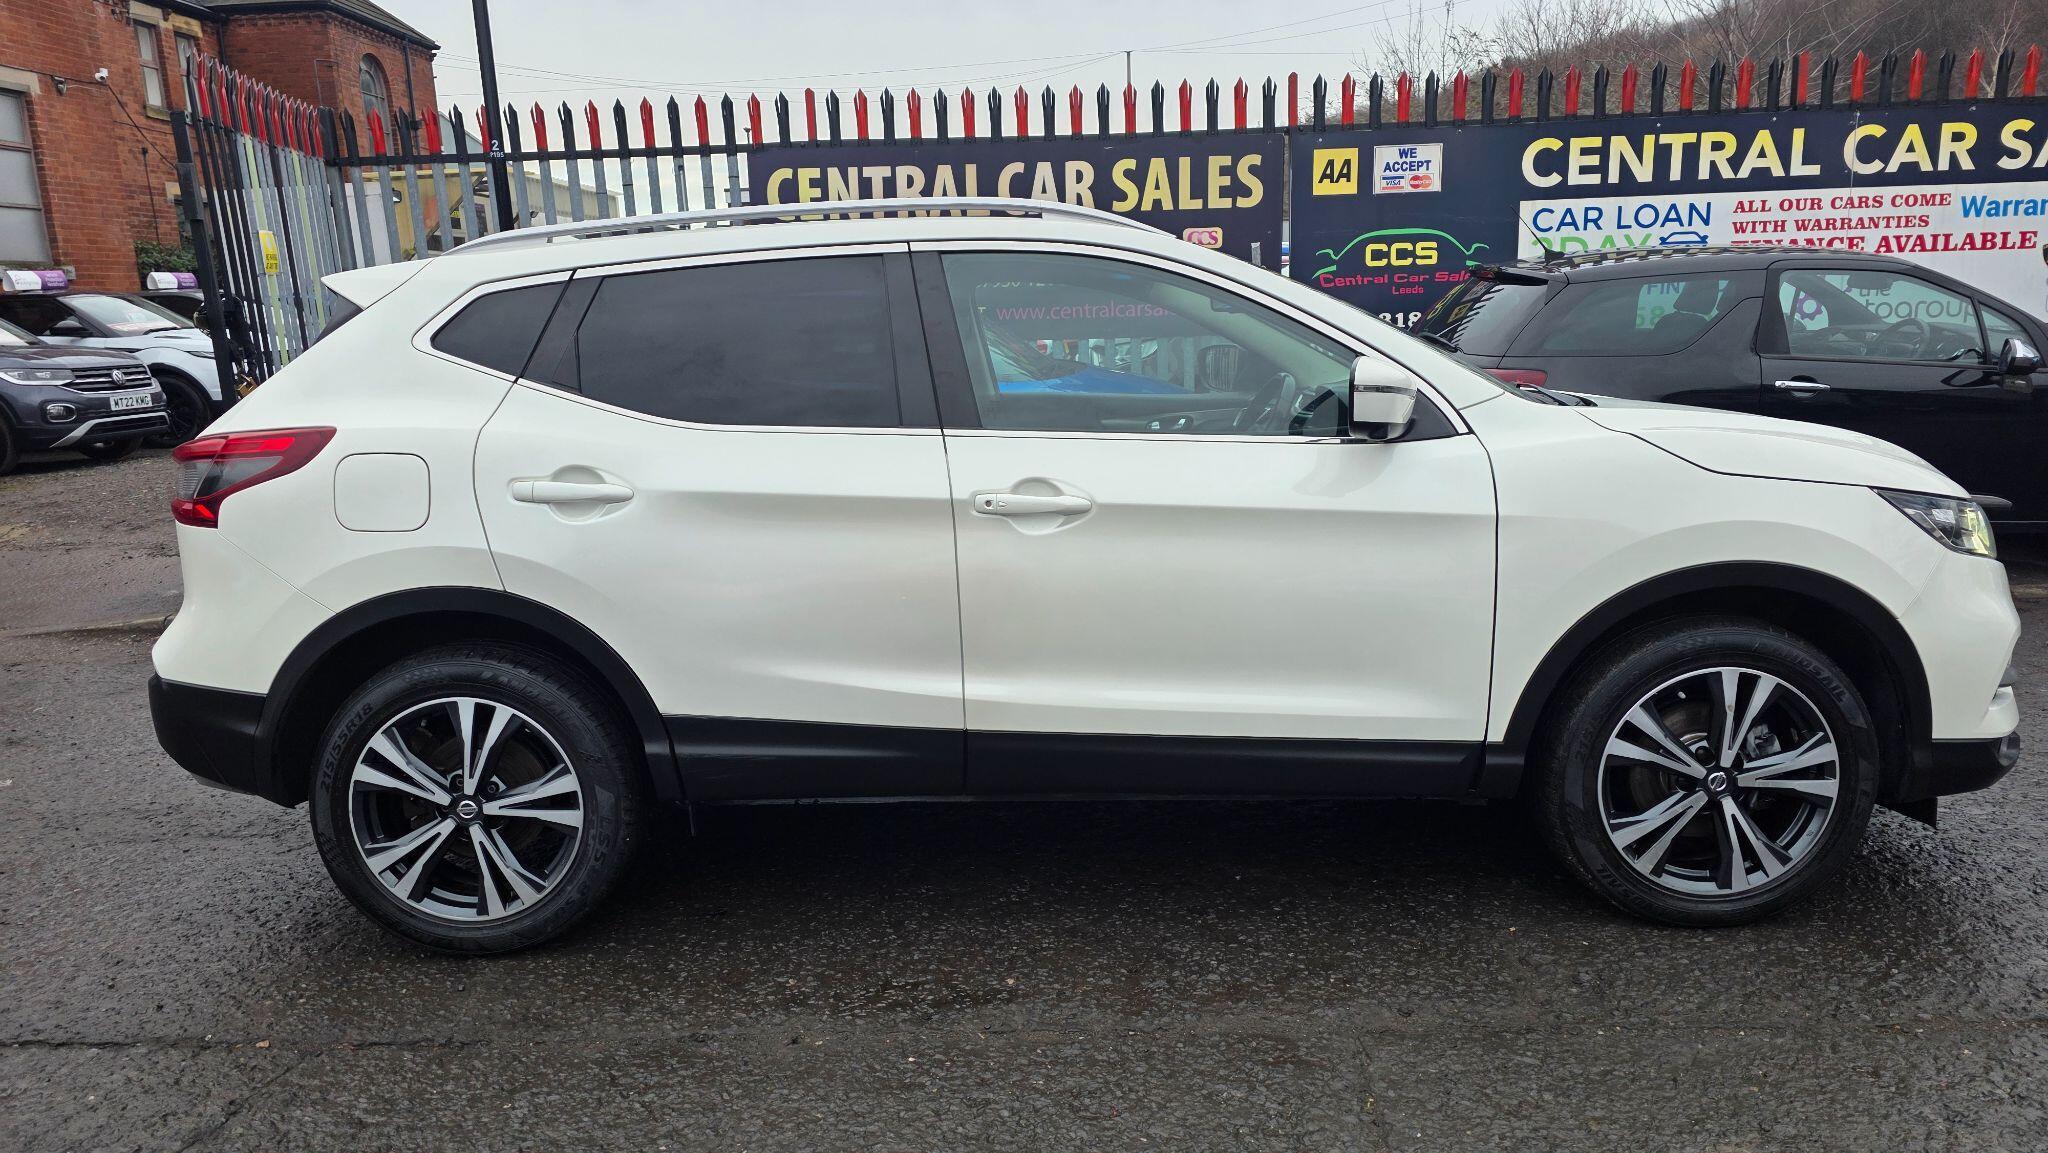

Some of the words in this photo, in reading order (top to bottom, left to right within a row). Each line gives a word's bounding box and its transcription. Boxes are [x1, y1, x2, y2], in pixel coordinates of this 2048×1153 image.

[1398, 147, 1418, 159] WE
[1522, 128, 1821, 187] CENTRAL
[1844, 122, 1977, 174] CAR
[1318, 158, 1352, 184] AA
[1383, 160, 1432, 173] ACCEPT
[767, 164, 990, 220] CENTRAL
[998, 160, 1095, 215] CAR
[1112, 153, 1264, 212] SALES
[1733, 199, 1772, 213] ALL
[1779, 196, 1824, 212] OUR
[1830, 194, 1884, 210] CARS
[1890, 192, 1952, 208] COME
[1532, 206, 1604, 233] CAR
[1616, 201, 1712, 229] LOAN
[1732, 219, 1794, 234] WITH
[1794, 214, 1930, 232] WARRANTIES
[1873, 230, 2039, 254] AVAILABLE
[1365, 241, 1438, 267] CCS
[1319, 272, 1389, 287] Central
[1394, 272, 1429, 283] Car
[1392, 285, 1424, 295] Leeds
[113, 397, 135, 408] MT22
